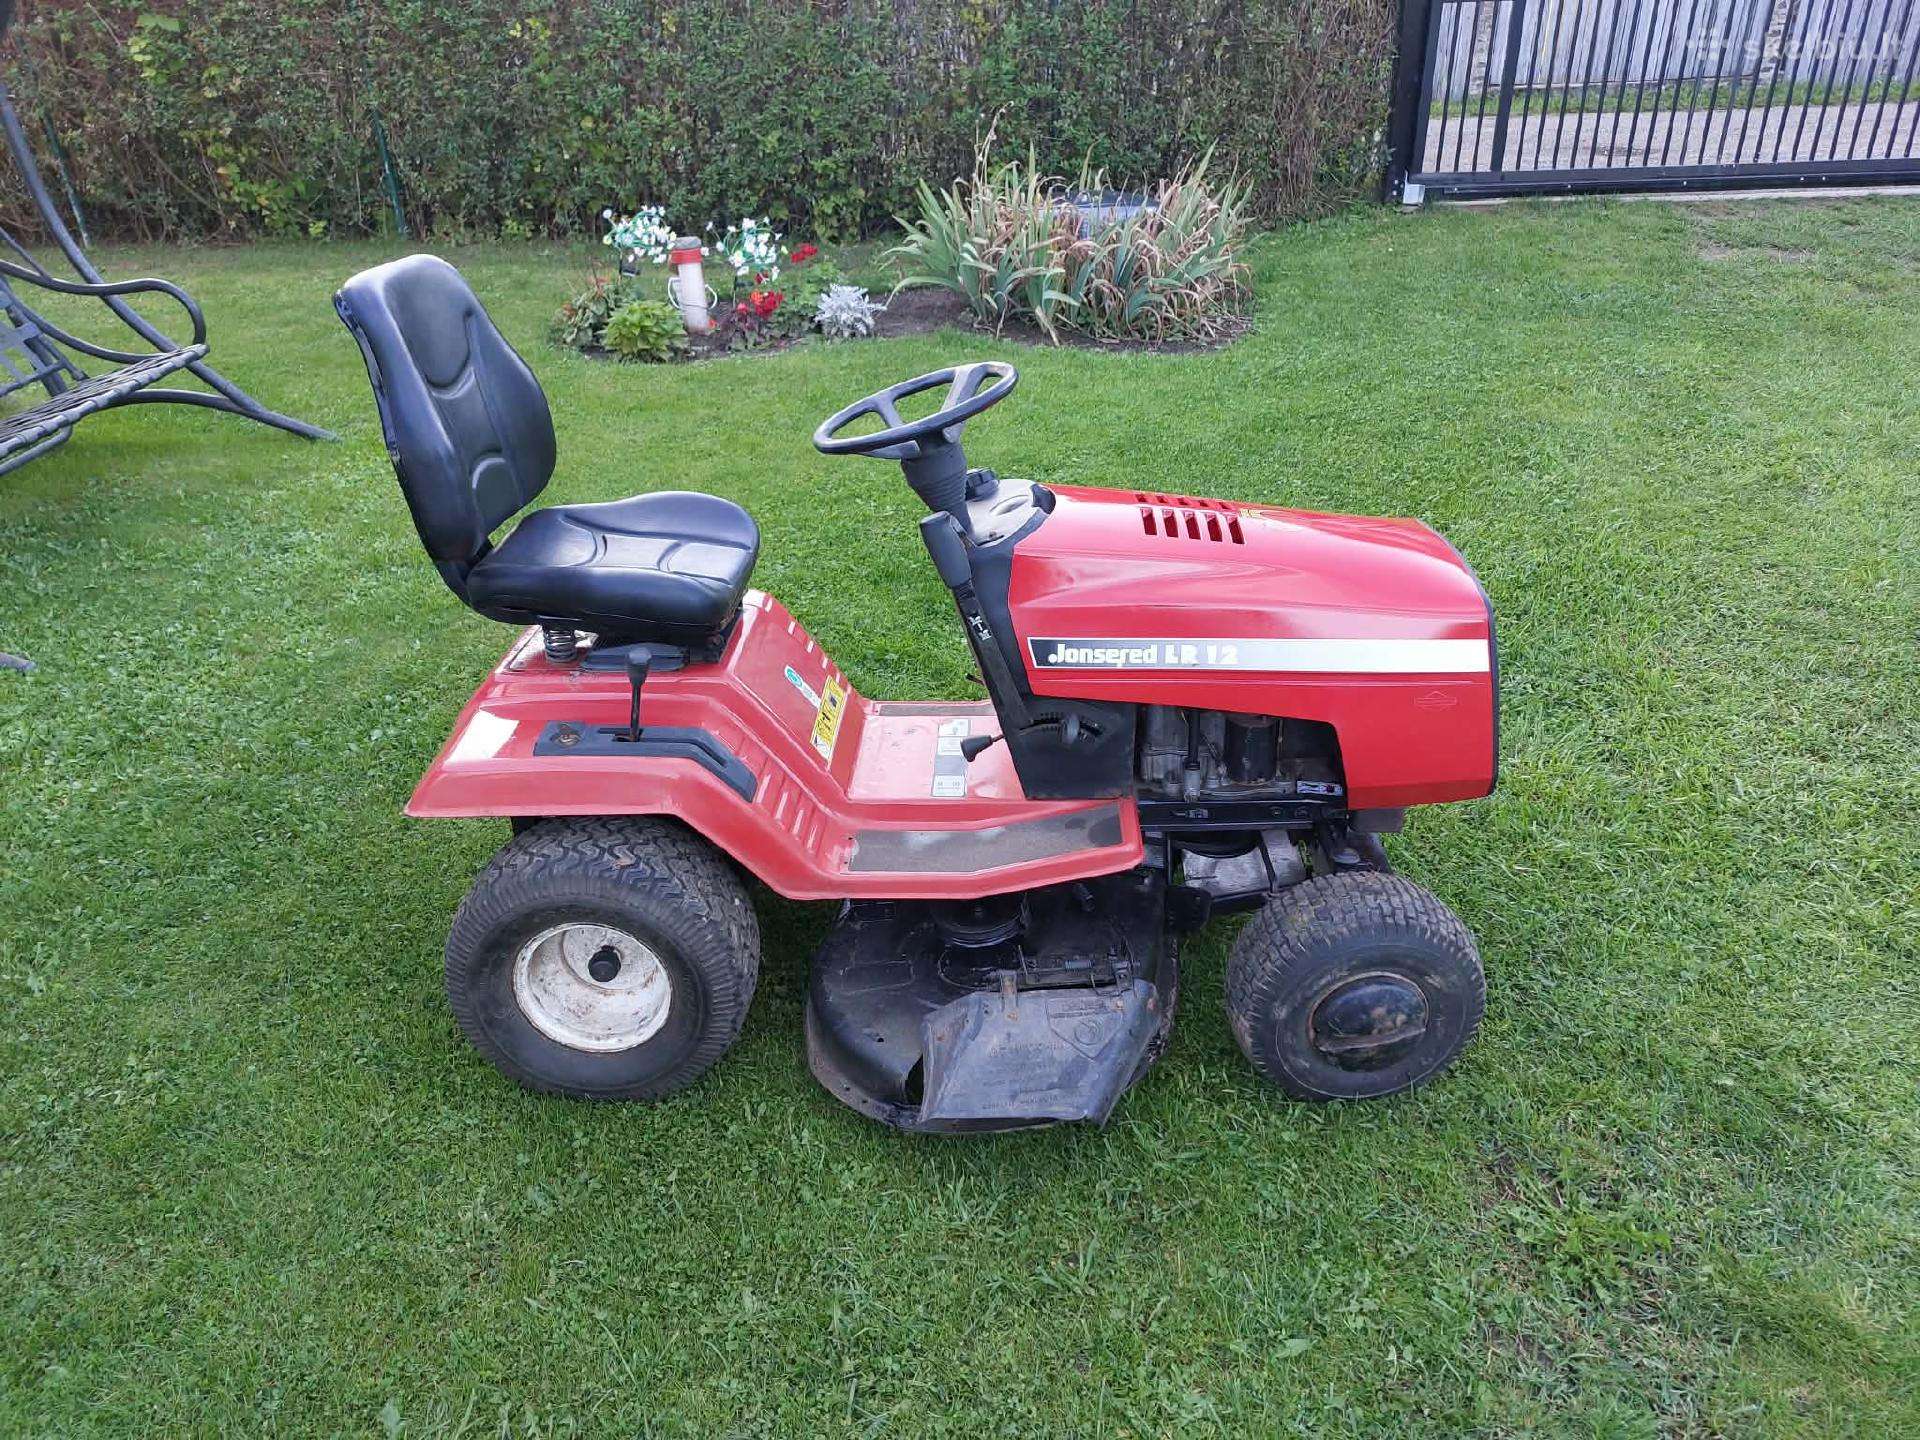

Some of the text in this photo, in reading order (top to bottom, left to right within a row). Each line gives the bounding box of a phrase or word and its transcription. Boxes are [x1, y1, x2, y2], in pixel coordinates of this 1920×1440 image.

[1047, 643, 1239, 668] Jonsered LR 12
